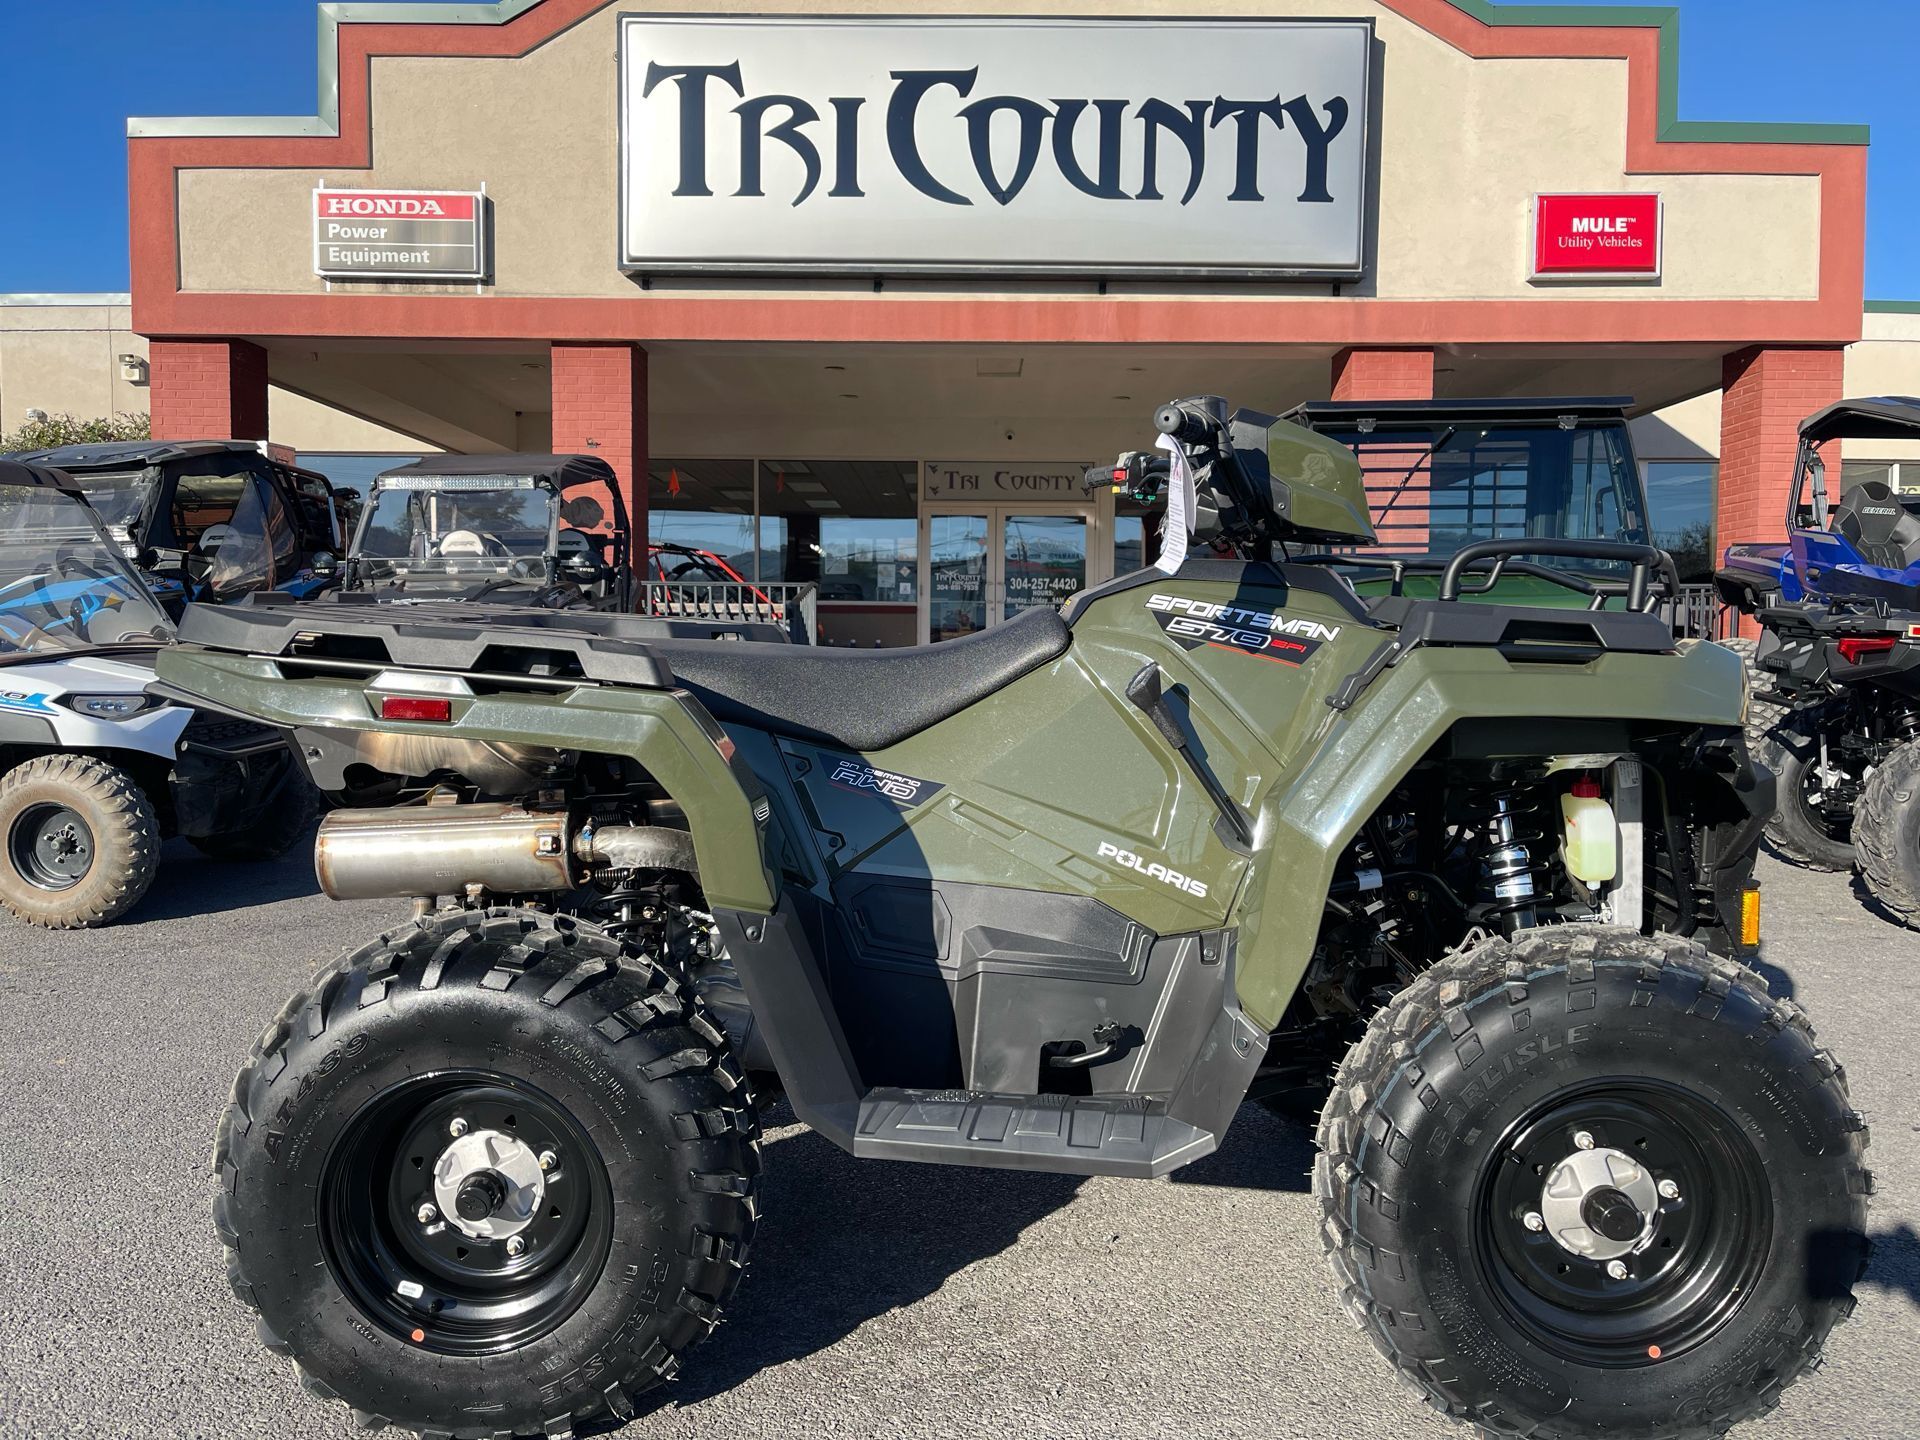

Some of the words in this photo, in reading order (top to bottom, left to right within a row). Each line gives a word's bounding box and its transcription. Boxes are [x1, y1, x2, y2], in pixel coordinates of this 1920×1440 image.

[327, 198, 445, 215] HONDA
[328, 223, 388, 239] Power
[1558, 236, 1594, 250] Utility
[1597, 236, 1643, 247] Vehicles
[329, 247, 430, 265] Equipment
[1861, 506, 1896, 516] GENERAL
[1009, 577, 1077, 590] 304-257-4420
[1031, 597, 1048, 605] Friday
[1145, 595, 1342, 642] SPORTSMAN
[1166, 617, 1271, 649] 570
[831, 767, 917, 800] AWD
[864, 768, 921, 787] DEMAND
[1097, 841, 1208, 898] POLARIS
[263, 1033, 371, 1163] AT489
